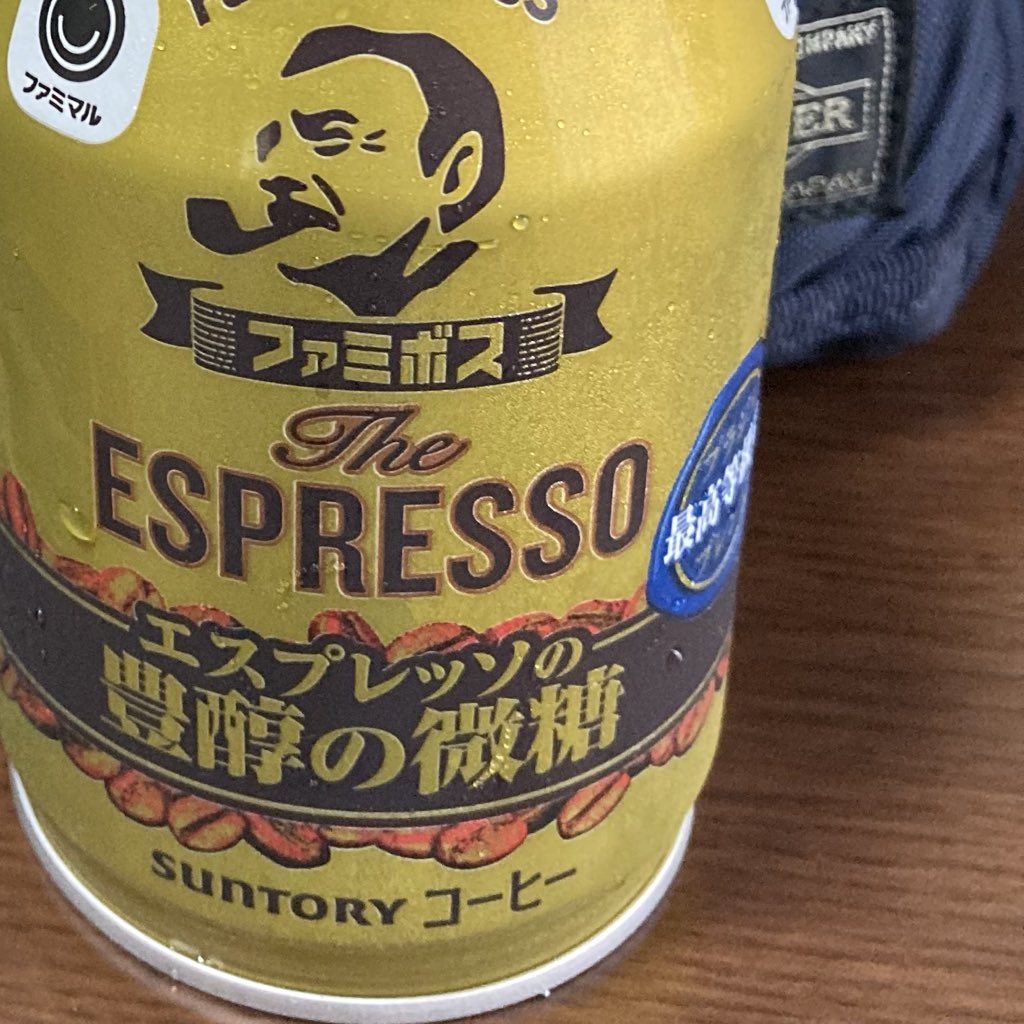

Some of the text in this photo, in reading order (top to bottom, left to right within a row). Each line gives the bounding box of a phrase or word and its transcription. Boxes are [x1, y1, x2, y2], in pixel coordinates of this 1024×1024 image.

[23, 71, 102, 127] ファミマル
[247, 319, 506, 385] ファミボス
[269, 404, 471, 476] The
[91, 419, 652, 598] ESPRESSO
[139, 616, 583, 704] エスプレッソの
[102, 642, 626, 795] 豊醇の微糖
[151, 848, 577, 929] SUNTORY コーヒー
